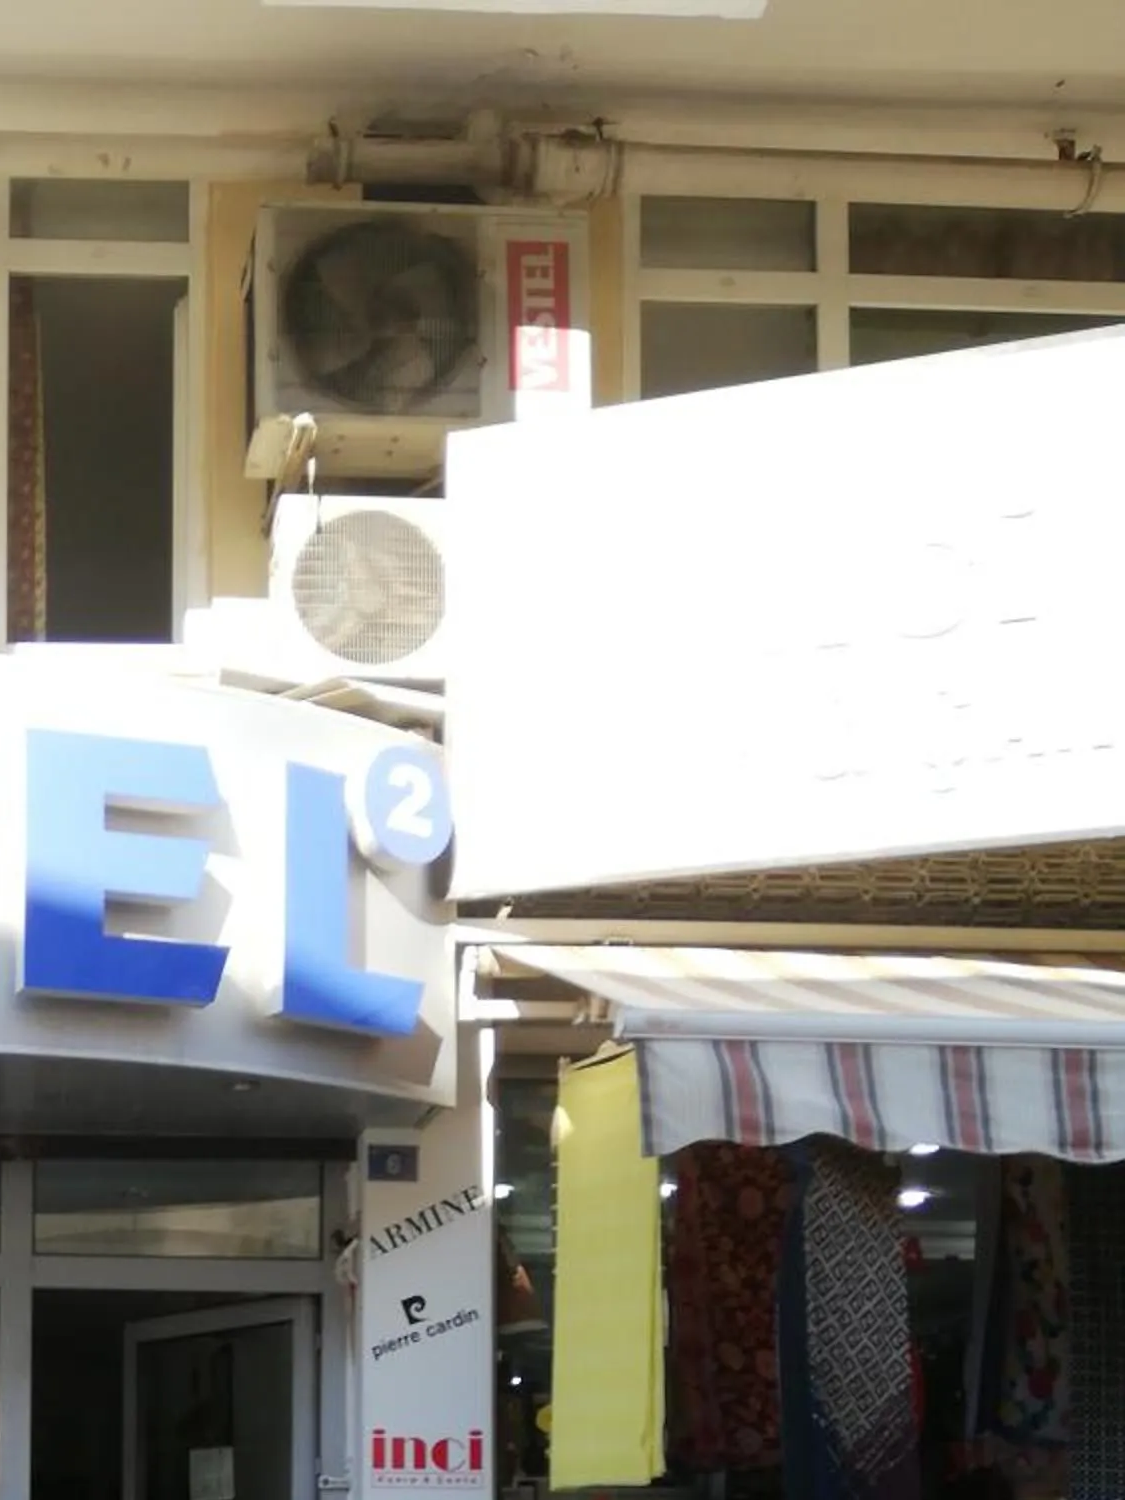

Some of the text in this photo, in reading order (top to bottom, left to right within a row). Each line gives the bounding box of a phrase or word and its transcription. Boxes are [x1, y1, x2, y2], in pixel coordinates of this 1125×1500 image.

[519, 244, 558, 390] VESTEL
[369, 1184, 485, 1260] ARMINE
[371, 1308, 480, 1360] pierre cardin
[371, 1429, 484, 1472] inci
